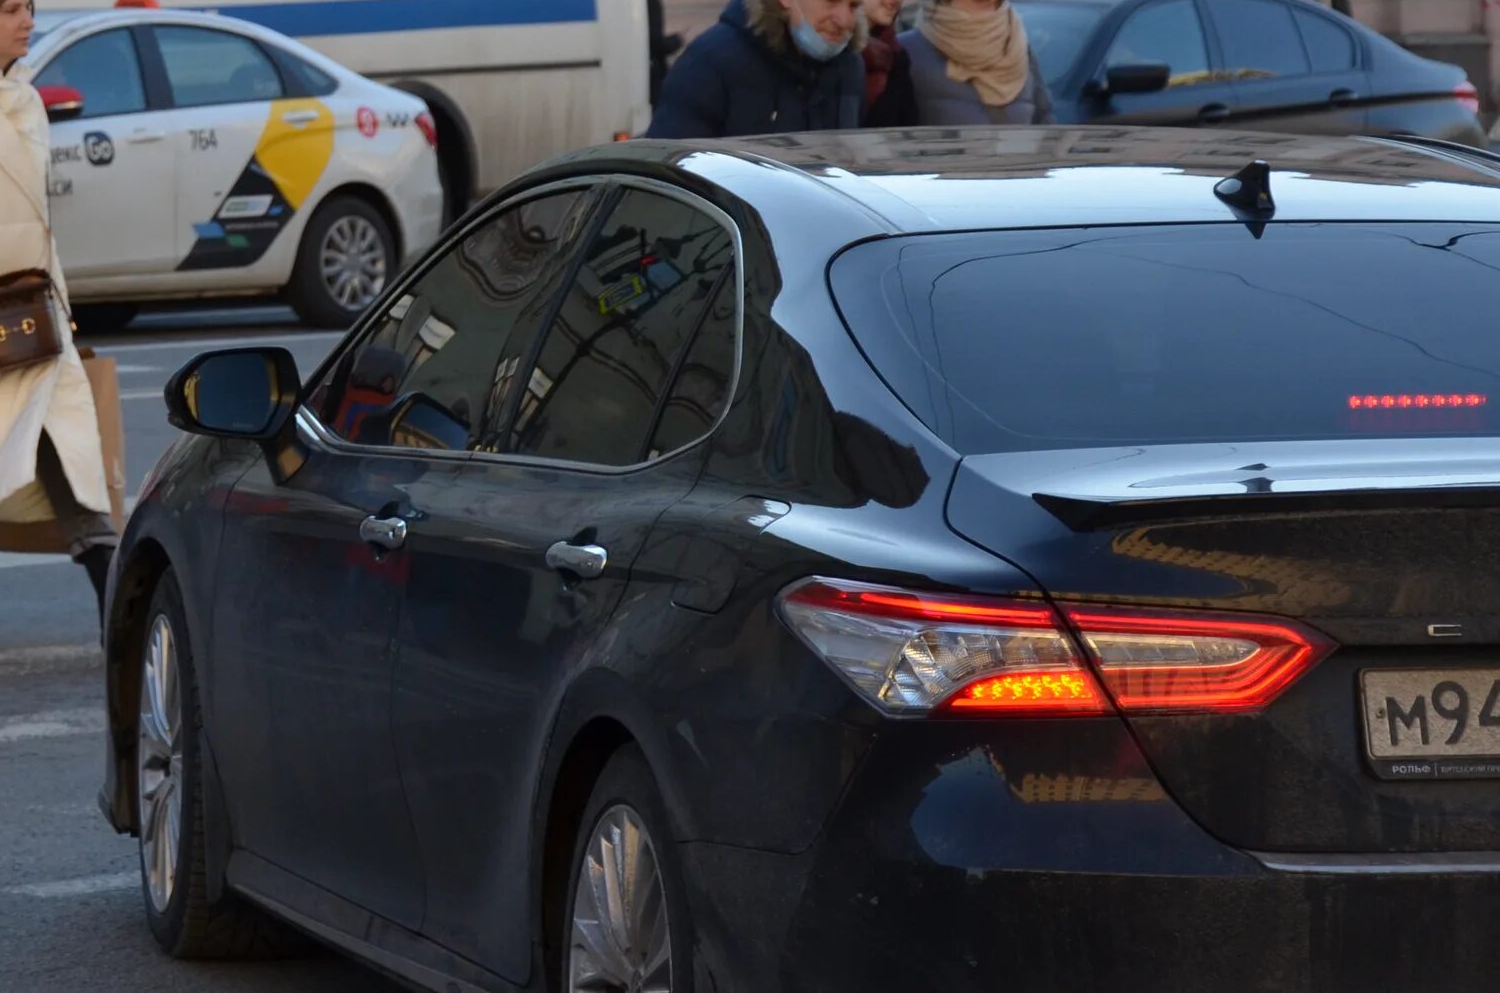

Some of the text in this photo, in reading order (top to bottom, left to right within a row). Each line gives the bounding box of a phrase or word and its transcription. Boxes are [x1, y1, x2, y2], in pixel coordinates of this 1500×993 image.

[86, 135, 114, 161] Go
[189, 128, 218, 150] 764
[1392, 765, 1432, 774] РОЛЬФ
